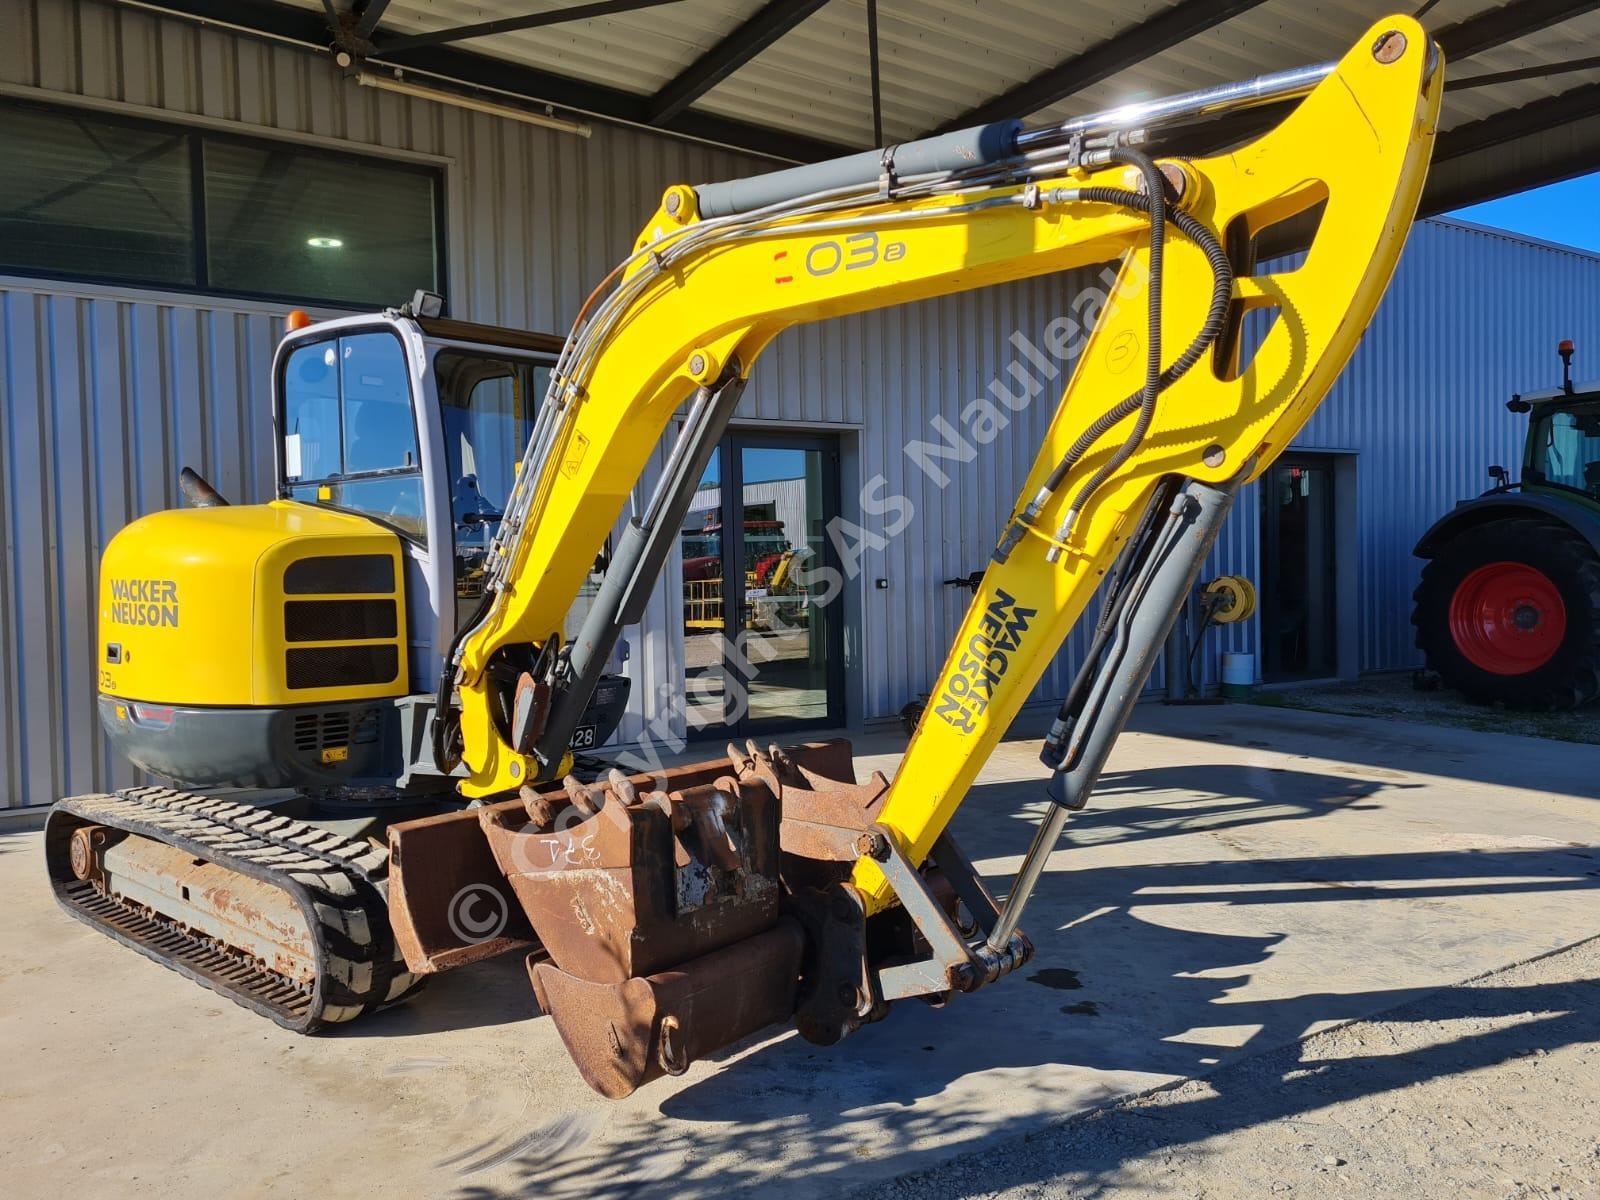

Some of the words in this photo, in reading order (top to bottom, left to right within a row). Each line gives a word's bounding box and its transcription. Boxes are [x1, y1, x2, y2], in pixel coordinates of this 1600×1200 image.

[111, 579, 178, 602] WACKER
[112, 602, 178, 627] NEUSON
[935, 588, 1016, 724] NEUSON
[953, 606, 1037, 734] WACKER
